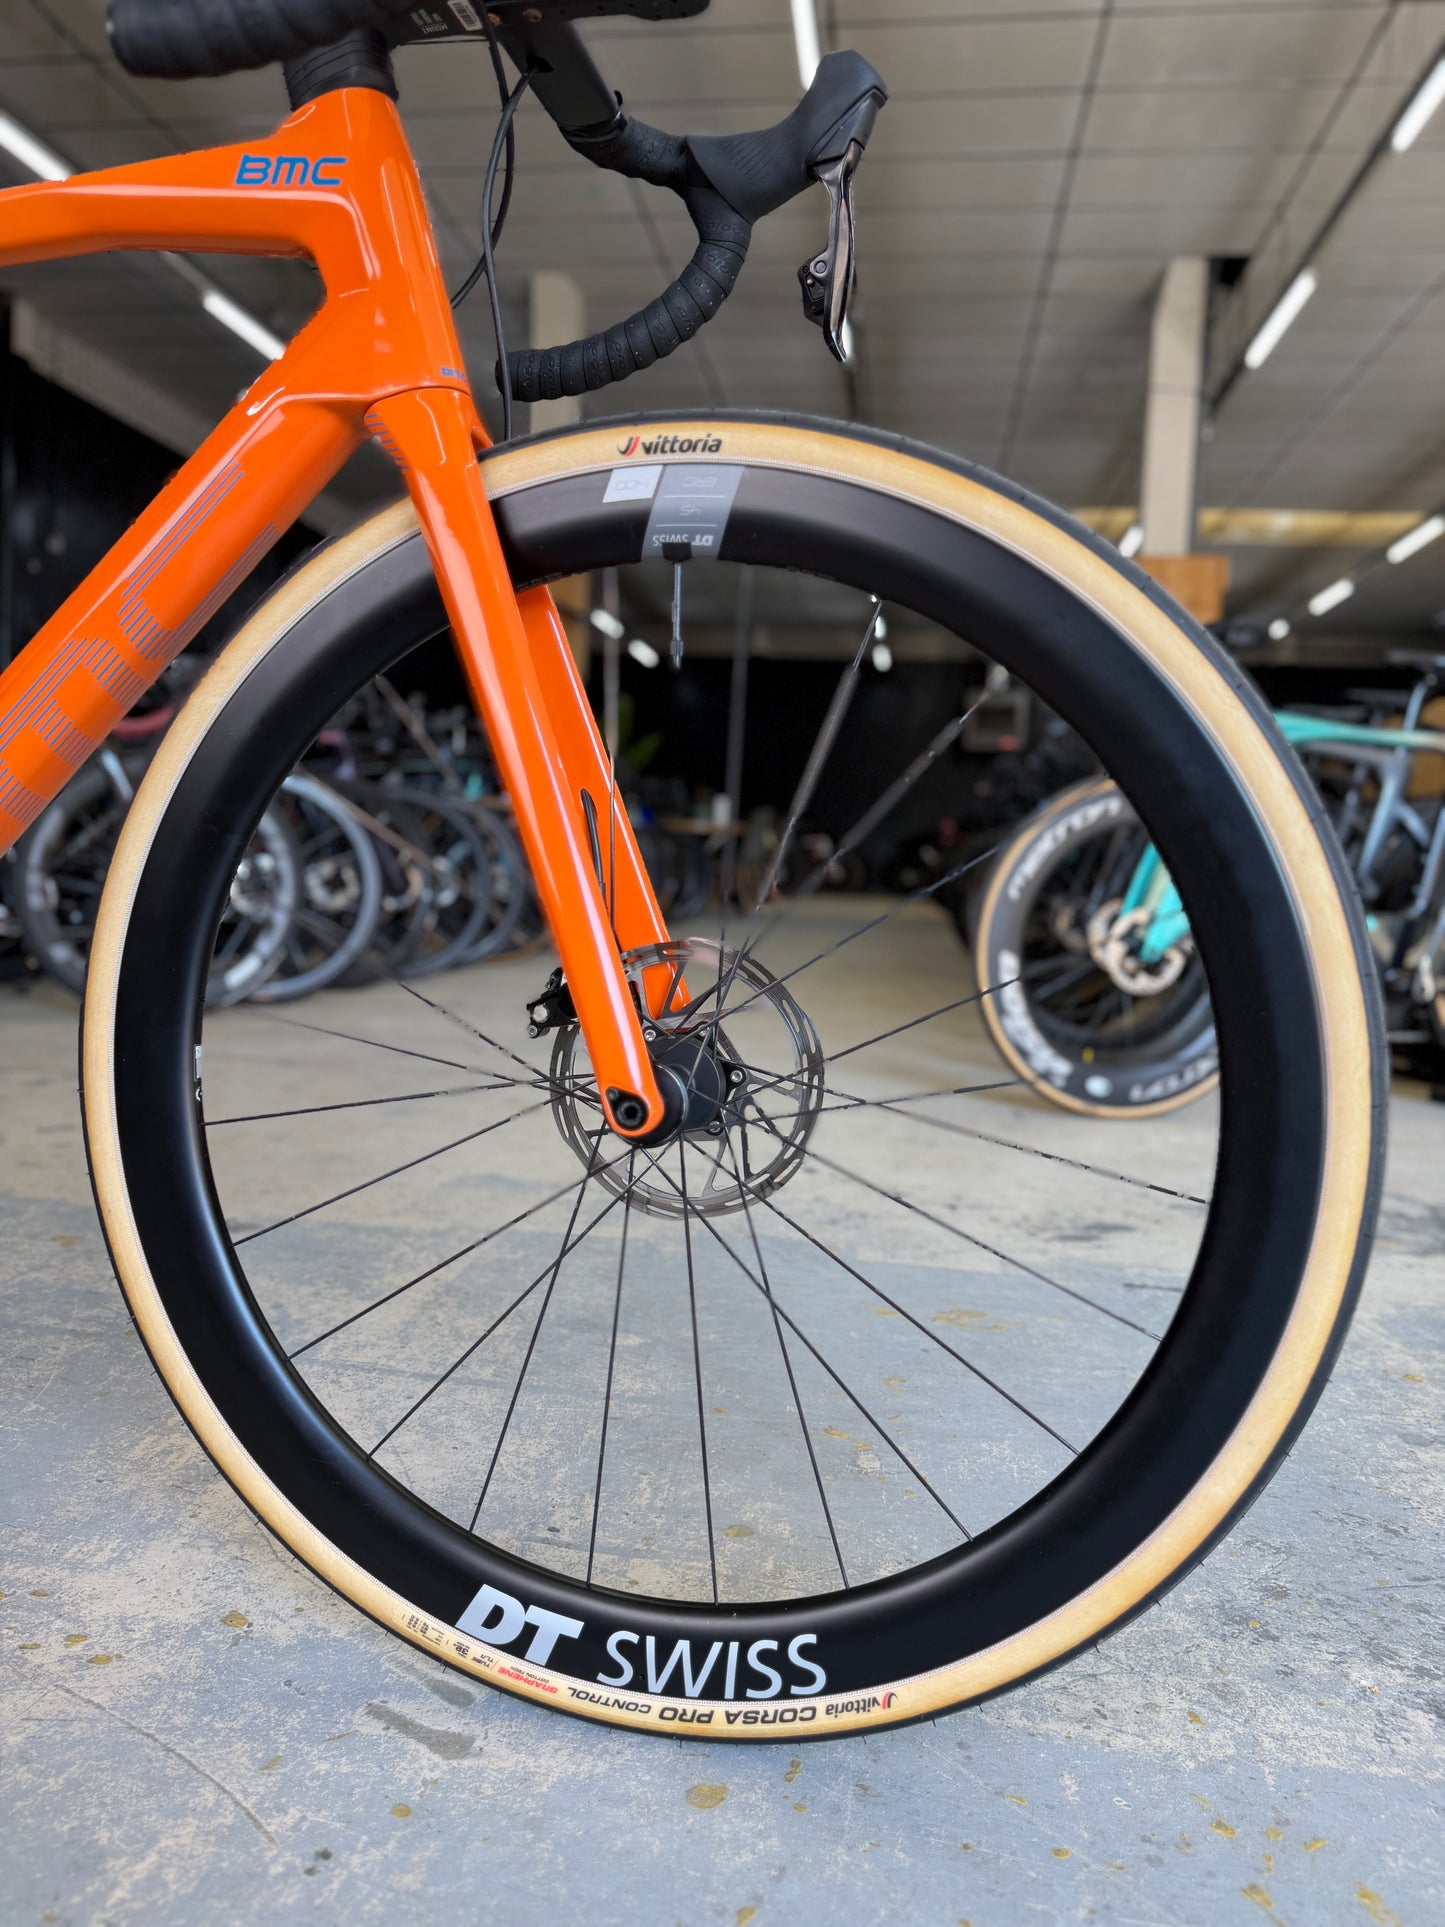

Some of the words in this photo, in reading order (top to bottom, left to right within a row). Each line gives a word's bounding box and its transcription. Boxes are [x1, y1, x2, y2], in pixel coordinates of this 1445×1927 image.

[235, 153, 348, 186] BMC
[640, 433, 723, 455] vittoria
[691, 534, 714, 546] DT
[455, 1583, 585, 1667] DT
[596, 1630, 828, 1700] SWISS
[498, 1666, 558, 1694] GRAPHENE
[568, 1686, 652, 1714] CONTROL
[825, 1697, 881, 1718] vittoria
[658, 1706, 715, 1724] PRO
[725, 1706, 817, 1725] CORSA
